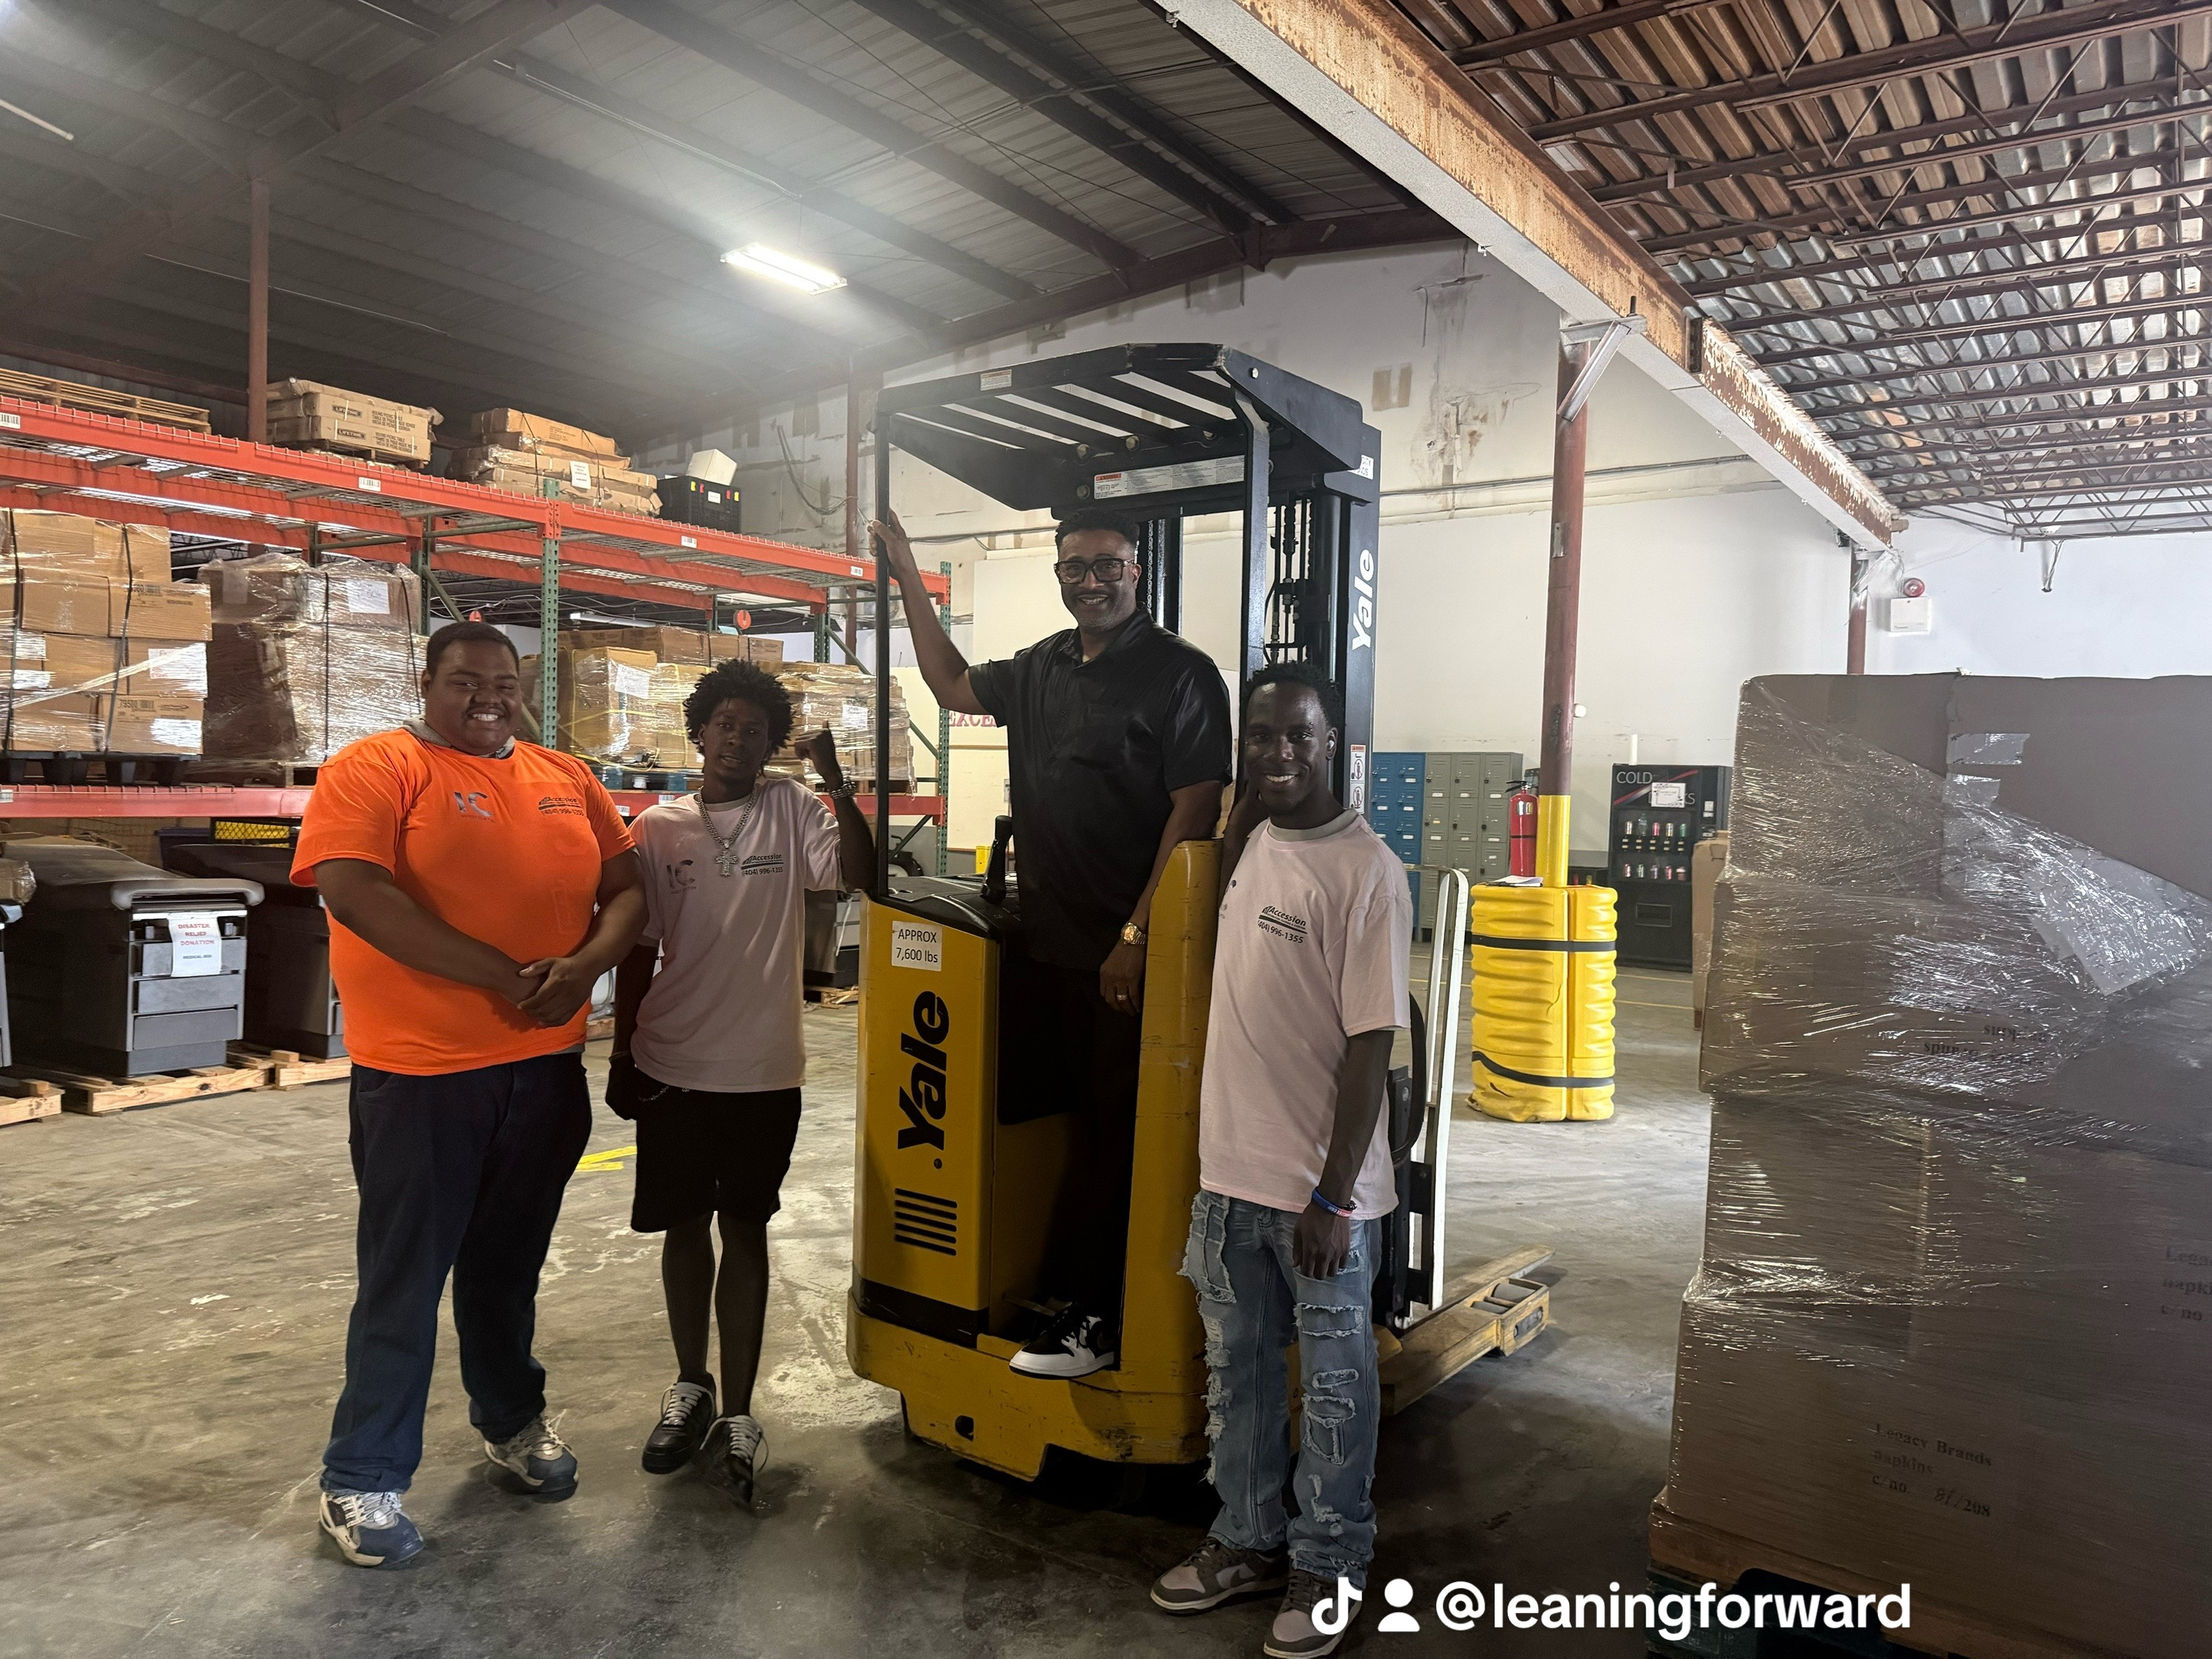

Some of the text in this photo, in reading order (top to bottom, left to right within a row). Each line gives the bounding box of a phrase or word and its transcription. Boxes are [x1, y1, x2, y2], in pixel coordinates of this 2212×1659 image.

[1352, 549, 1374, 650] Yale
[1616, 771, 1653, 784] COLD
[741, 868, 758, 876] (404)
[1268, 906, 1306, 926] Accession
[898, 929, 937, 943] APPROX
[1270, 926, 1304, 944] 996-1355
[896, 947, 938, 962] 7,600 lbs
[897, 990, 949, 1151] Yale
[1875, 1422, 1993, 1467] Legacy Brands
[1872, 1449, 1934, 1475] napkins
